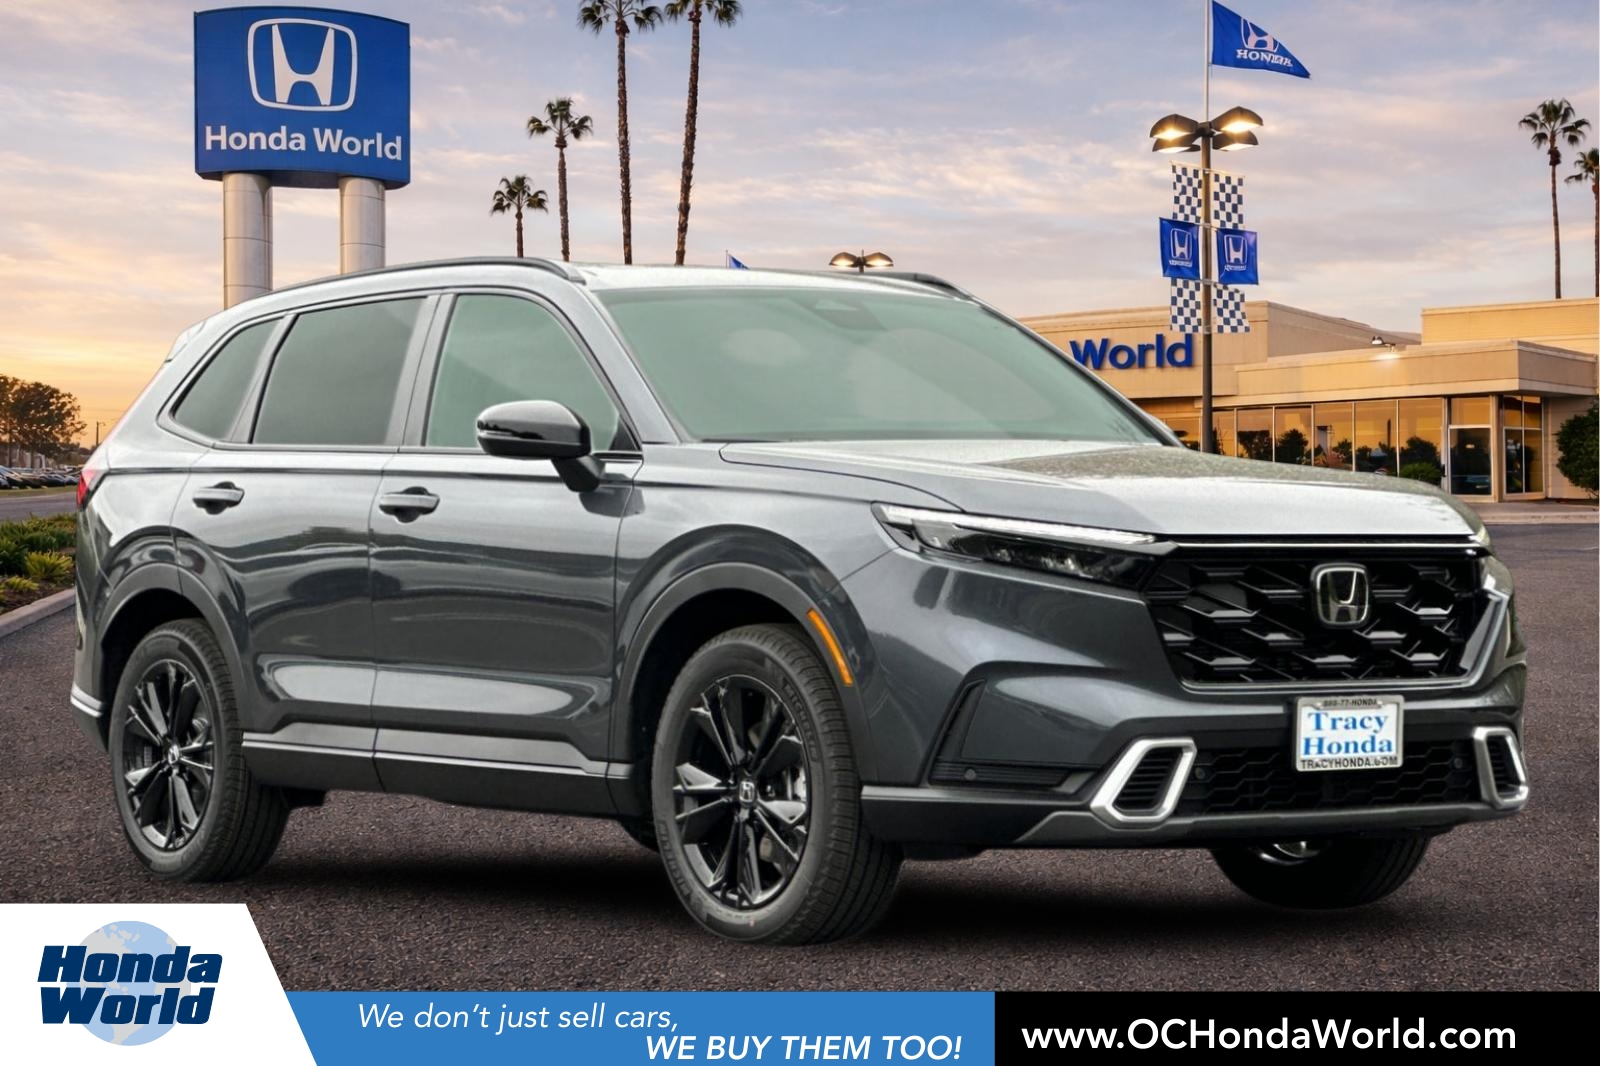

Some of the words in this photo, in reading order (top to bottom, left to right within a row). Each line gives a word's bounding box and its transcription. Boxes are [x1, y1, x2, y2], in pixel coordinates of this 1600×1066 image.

[205, 125, 306, 151] Honda
[312, 127, 402, 161] World
[1069, 333, 1194, 370] World
[1308, 712, 1388, 734] Tracy
[1303, 735, 1393, 755] Honda
